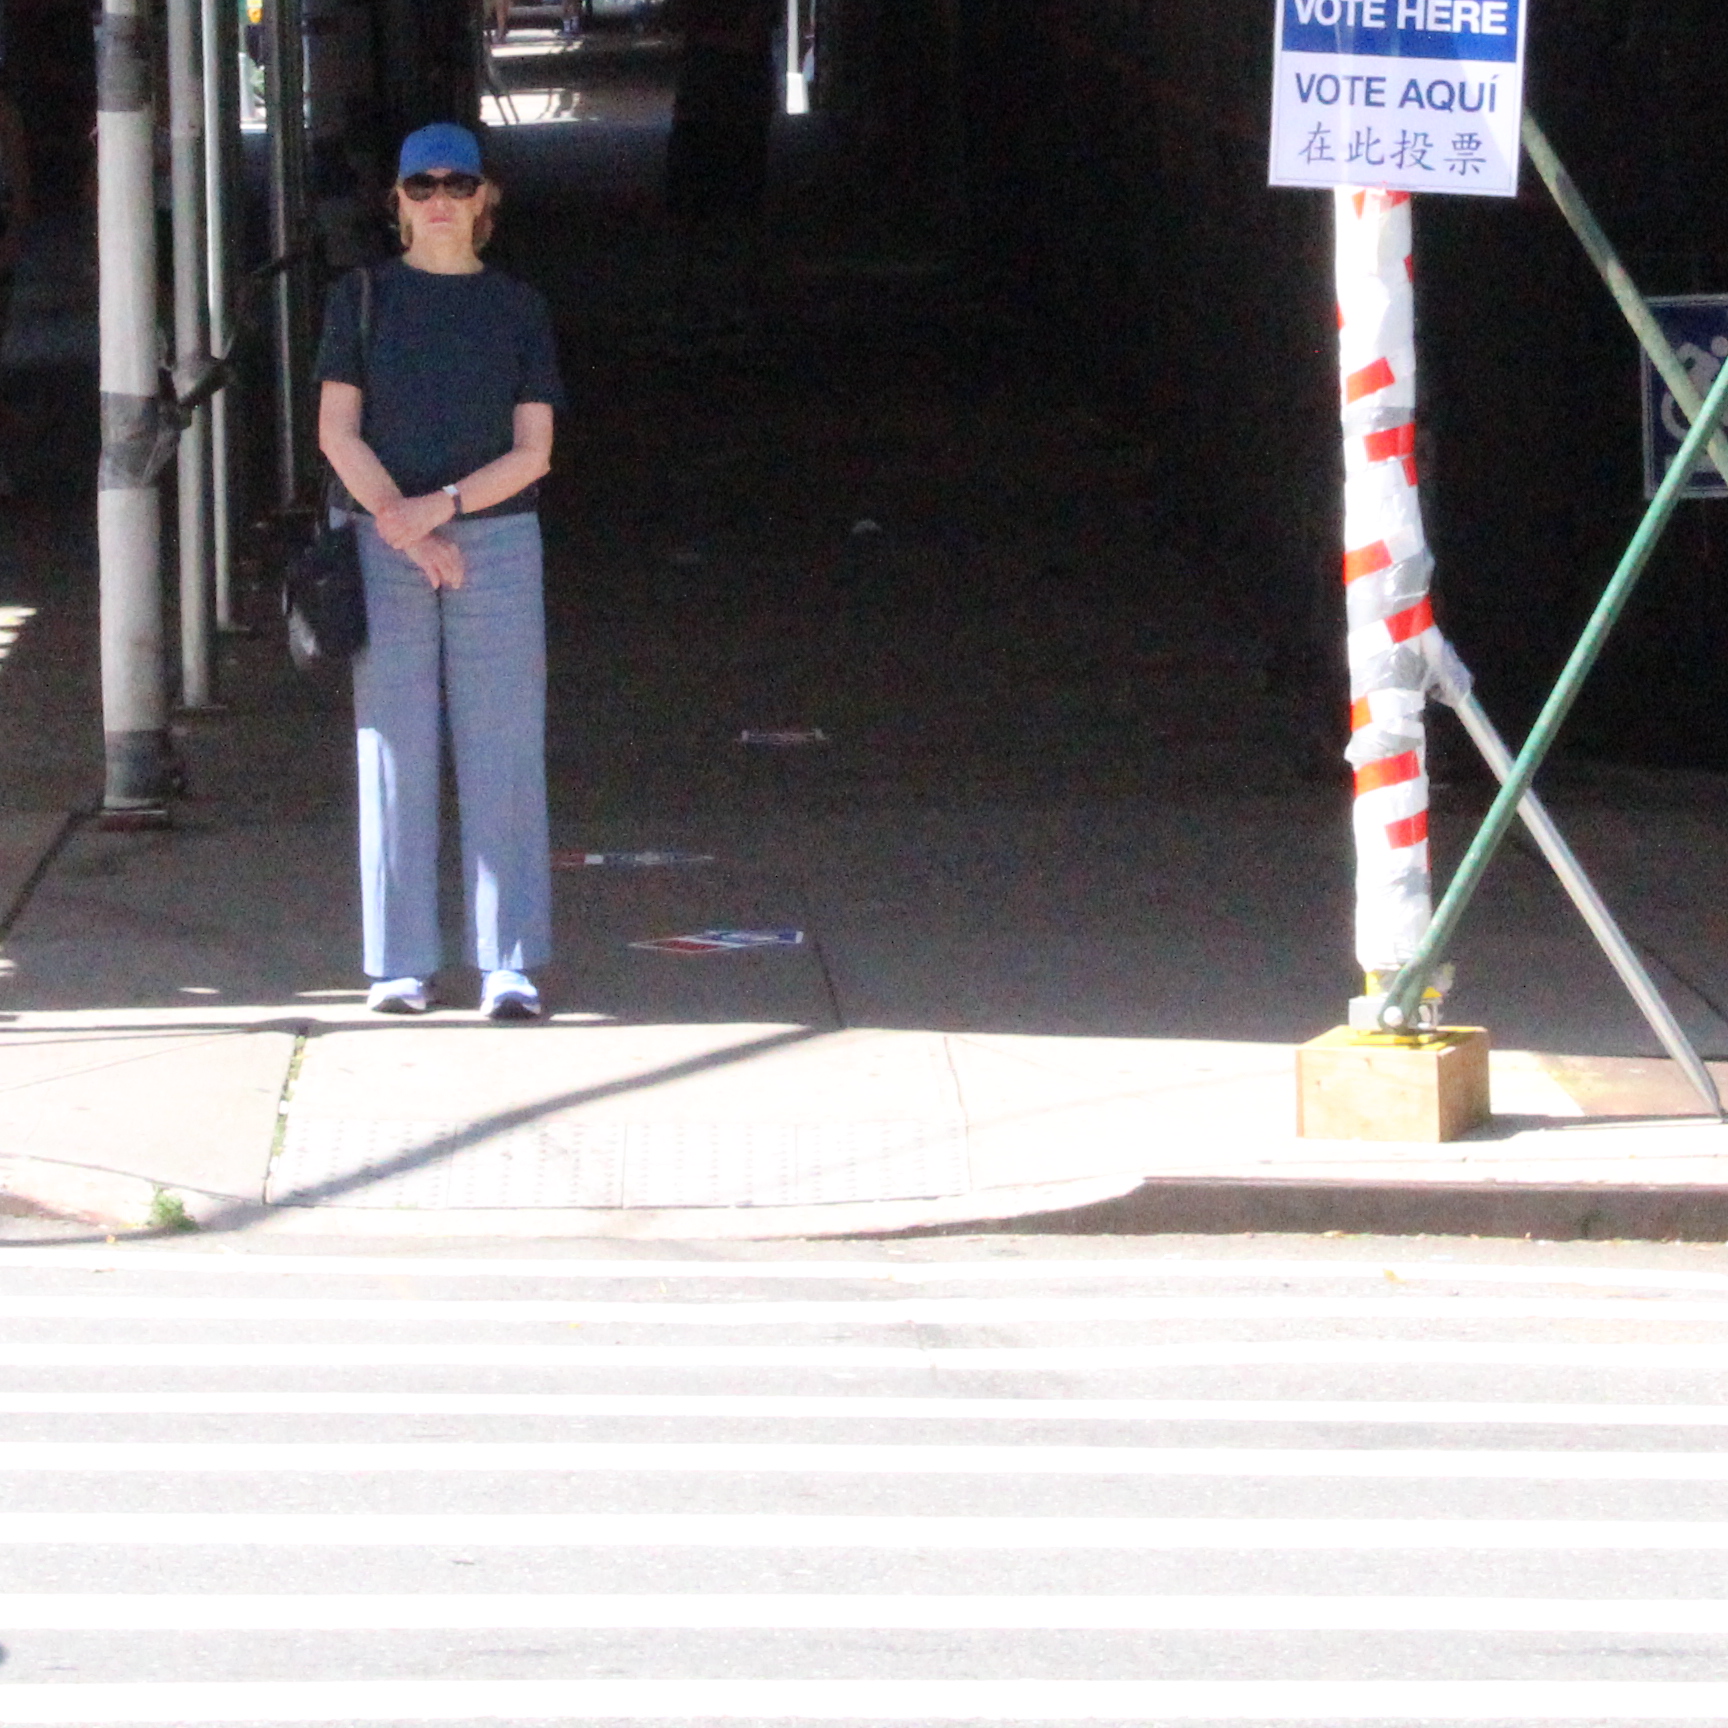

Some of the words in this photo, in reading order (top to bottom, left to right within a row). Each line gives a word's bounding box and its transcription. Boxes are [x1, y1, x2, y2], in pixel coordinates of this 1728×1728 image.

[1295, 72, 1386, 110] VOTE
[1398, 74, 1497, 114] AQUÍ
[1298, 121, 1488, 177] 在此投票
